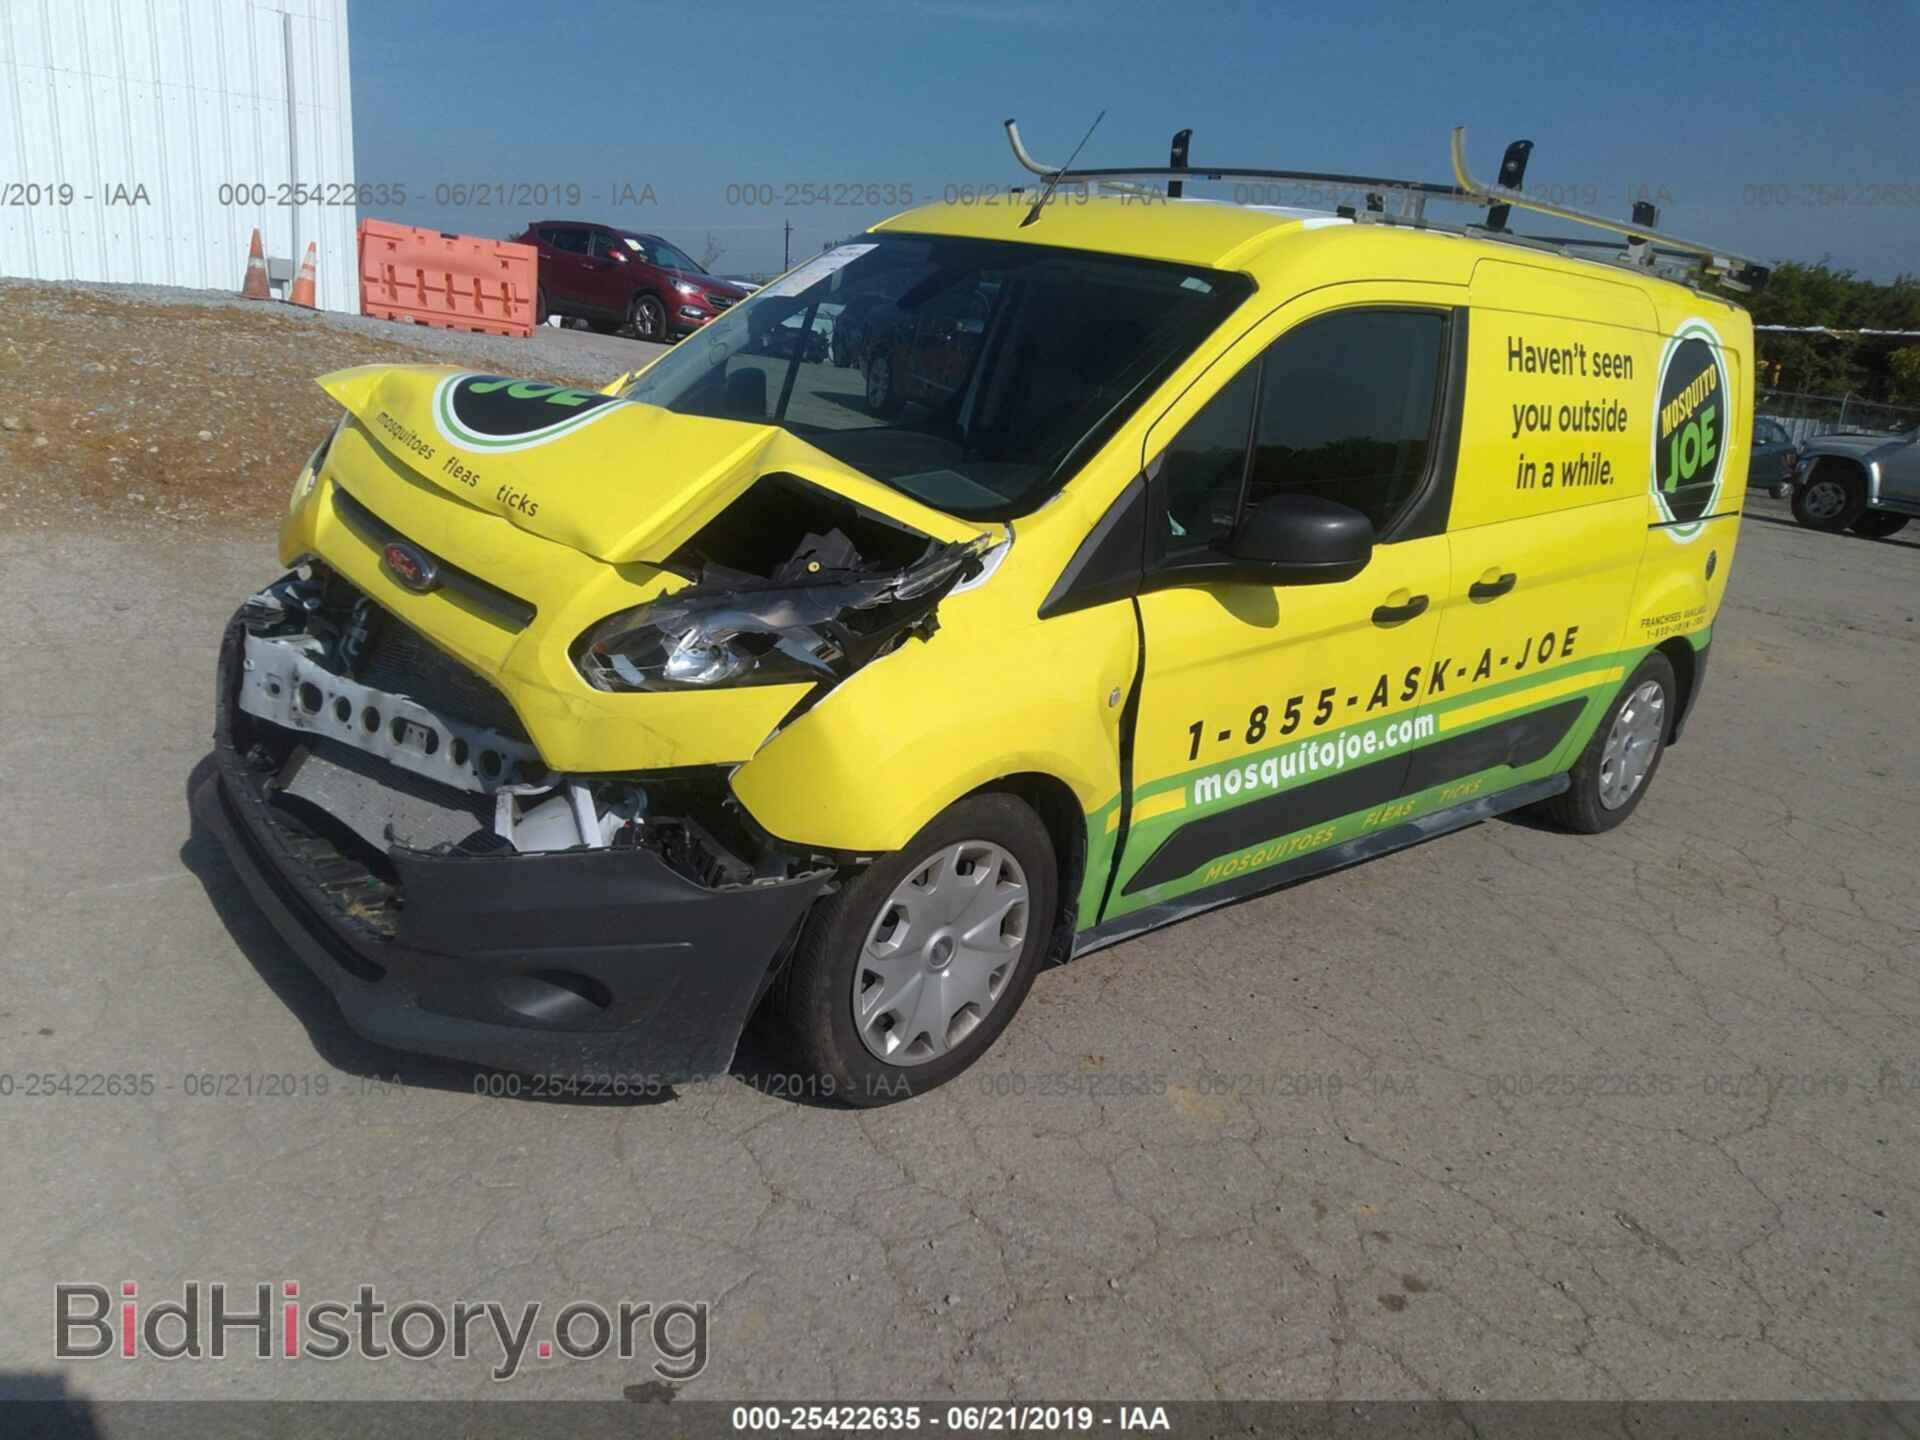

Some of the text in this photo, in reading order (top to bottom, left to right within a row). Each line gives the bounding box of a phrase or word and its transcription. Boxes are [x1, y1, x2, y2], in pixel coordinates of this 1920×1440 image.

[1507, 336, 1633, 380] Haven't seen
[1512, 398, 1628, 439] you outside
[1662, 363, 1716, 439] MOSQUITO
[376, 411, 539, 518] mosquitoes fleas ticks
[1516, 452, 1615, 489] in a while.
[1664, 404, 1716, 494] JOE
[1187, 625, 1579, 761] 1-855-ASK-A-JOE
[1194, 713, 1435, 805] mosquitojoe.com
[1203, 827, 1336, 883] MOSQUITOES
[1361, 800, 1416, 830] FLEAS
